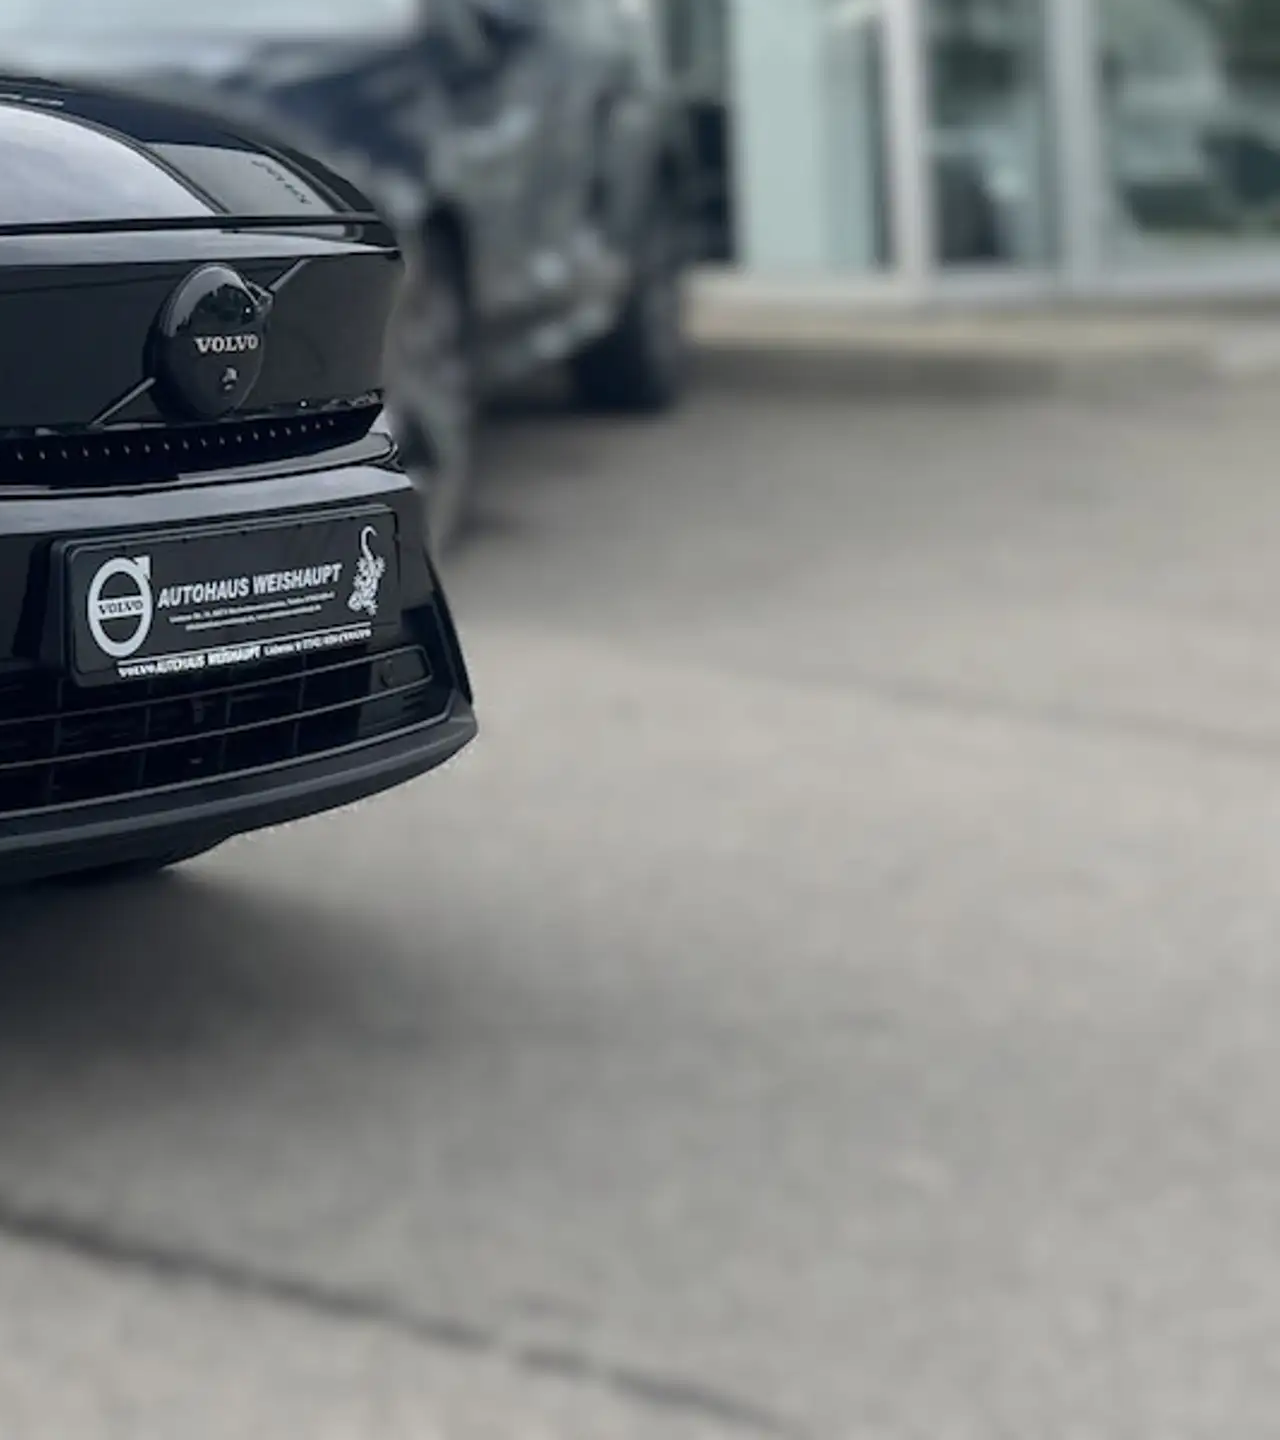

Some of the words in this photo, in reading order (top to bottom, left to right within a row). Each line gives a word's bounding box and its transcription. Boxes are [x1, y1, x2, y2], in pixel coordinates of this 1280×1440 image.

[194, 333, 259, 354] VOLVO
[157, 577, 250, 609] AUTOHAUS
[252, 563, 343, 596] WEISHAUPT
[98, 600, 144, 616] VOLVO
[156, 654, 205, 675] AUTOHAUS
[207, 644, 261, 666] WEISHAUPT
